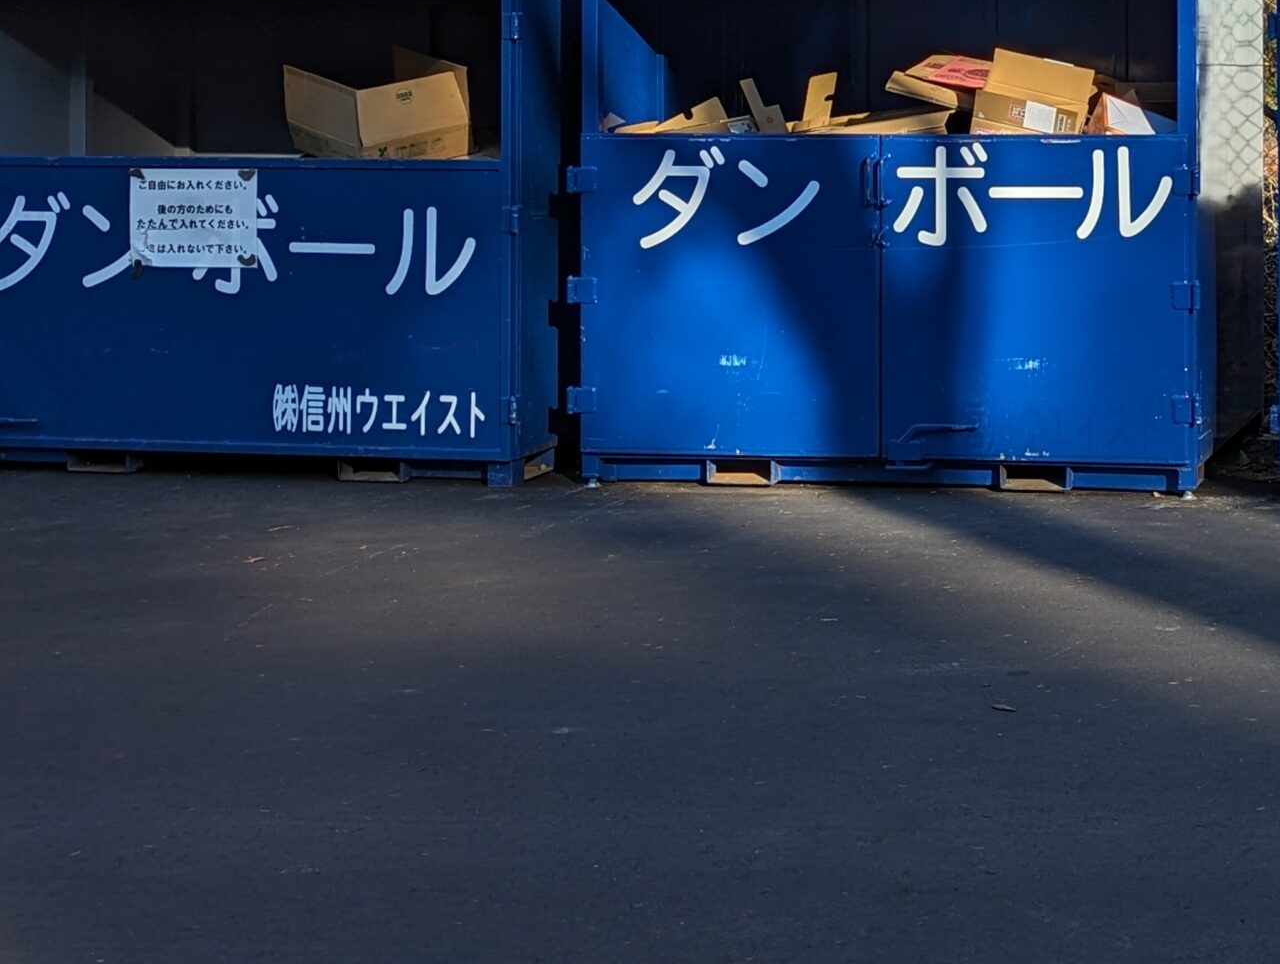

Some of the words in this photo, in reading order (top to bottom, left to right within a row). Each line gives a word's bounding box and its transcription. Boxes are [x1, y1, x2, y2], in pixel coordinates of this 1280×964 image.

[139, 179, 247, 191] ご自由にお入れください。
[633, 142, 1173, 249] ダンボール
[157, 204, 233, 215] 後の方のためにも
[136, 218, 250, 230] たたんで入れてください。
[141, 243, 248, 255] ミは入れないで下さい。
